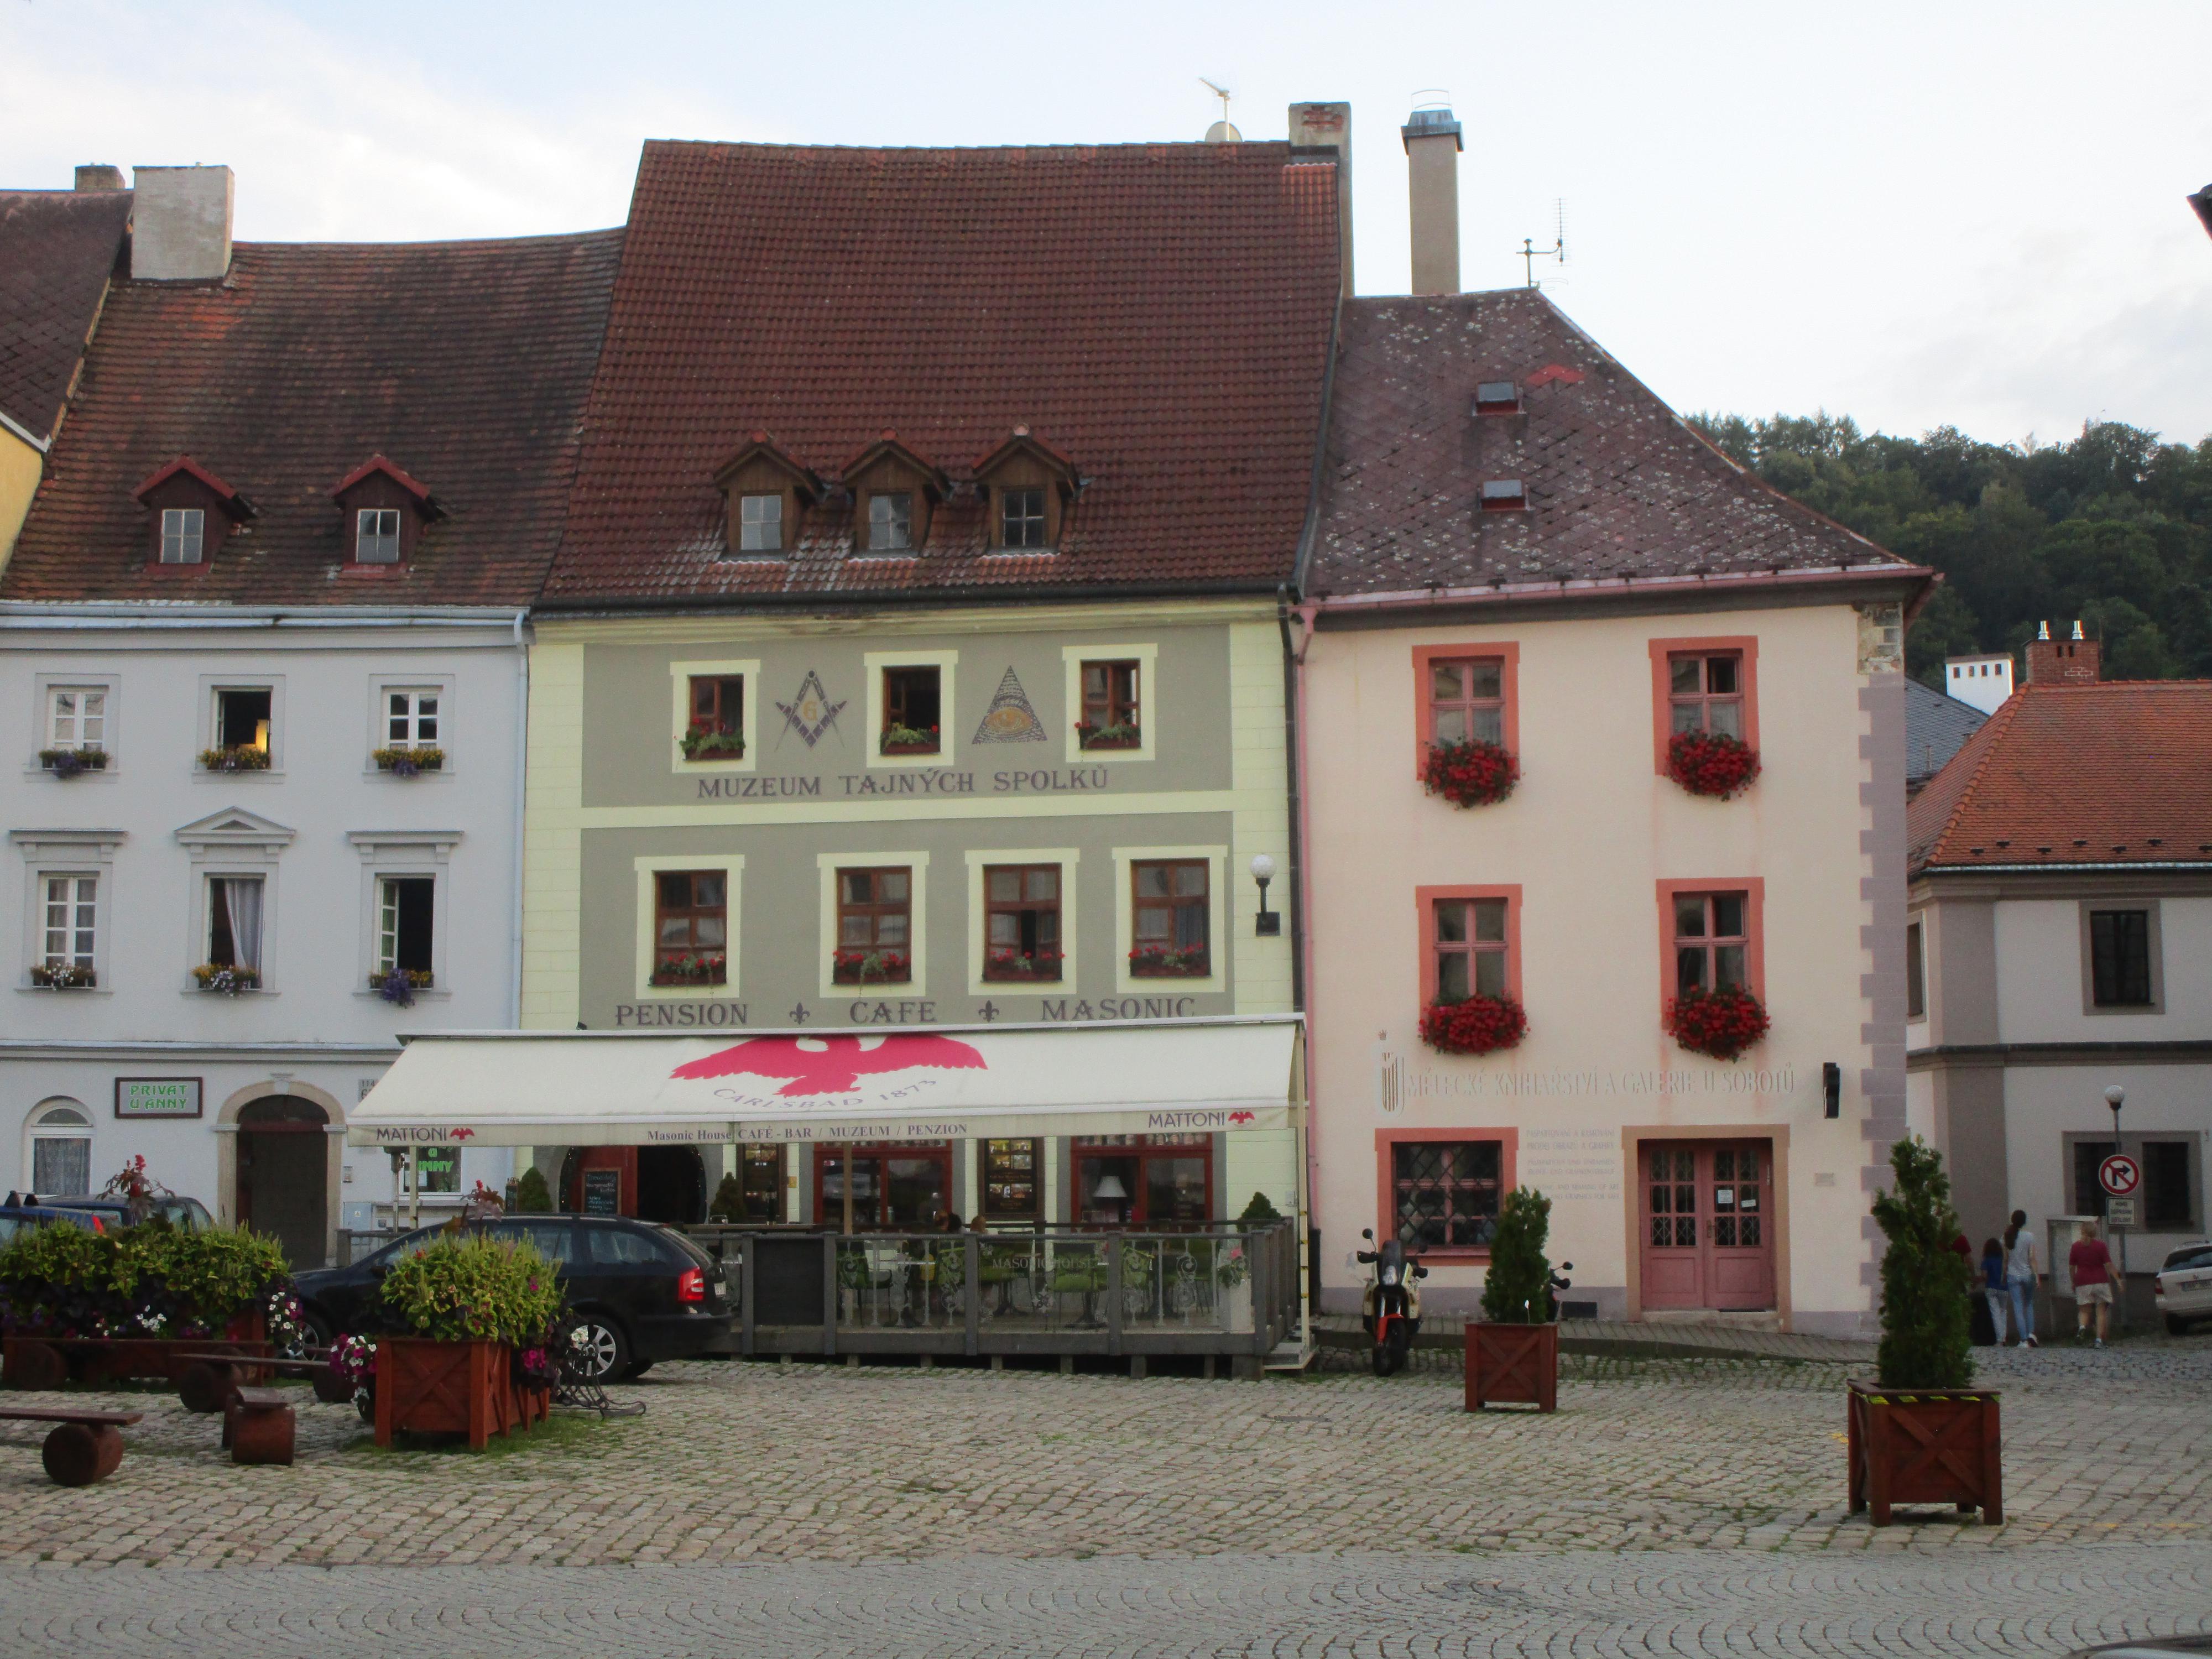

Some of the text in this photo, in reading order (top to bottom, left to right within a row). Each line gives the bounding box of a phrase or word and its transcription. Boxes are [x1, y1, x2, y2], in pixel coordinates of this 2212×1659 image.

[697, 764, 1109, 798] MUZEUM TAJNÝCH SPOLKŮ
[615, 997, 1195, 1026] PENSION CAFE MASONIC
[1605, 1071, 1616, 1094] A
[1623, 1070, 1697, 1094] GALERIE
[1704, 1071, 1714, 1093] U
[1722, 1061, 1794, 1093] SOBOTŮ
[129, 1084, 187, 1095] PRIVAT
[713, 1079, 937, 1108] CARLSBAD 1873
[129, 1098, 187, 1109] U ANNY
[1149, 1112, 1225, 1128] MATTONI
[376, 1128, 447, 1141] MATTONI
[648, 1130, 693, 1141] Masonic
[738, 1125, 773, 1139] CAFÉ
[785, 1128, 811, 1138] BAR
[830, 1125, 890, 1138] MUZEUM
[907, 1123, 967, 1135] PENZION
[992, 1258, 1047, 1269] MASOIC
